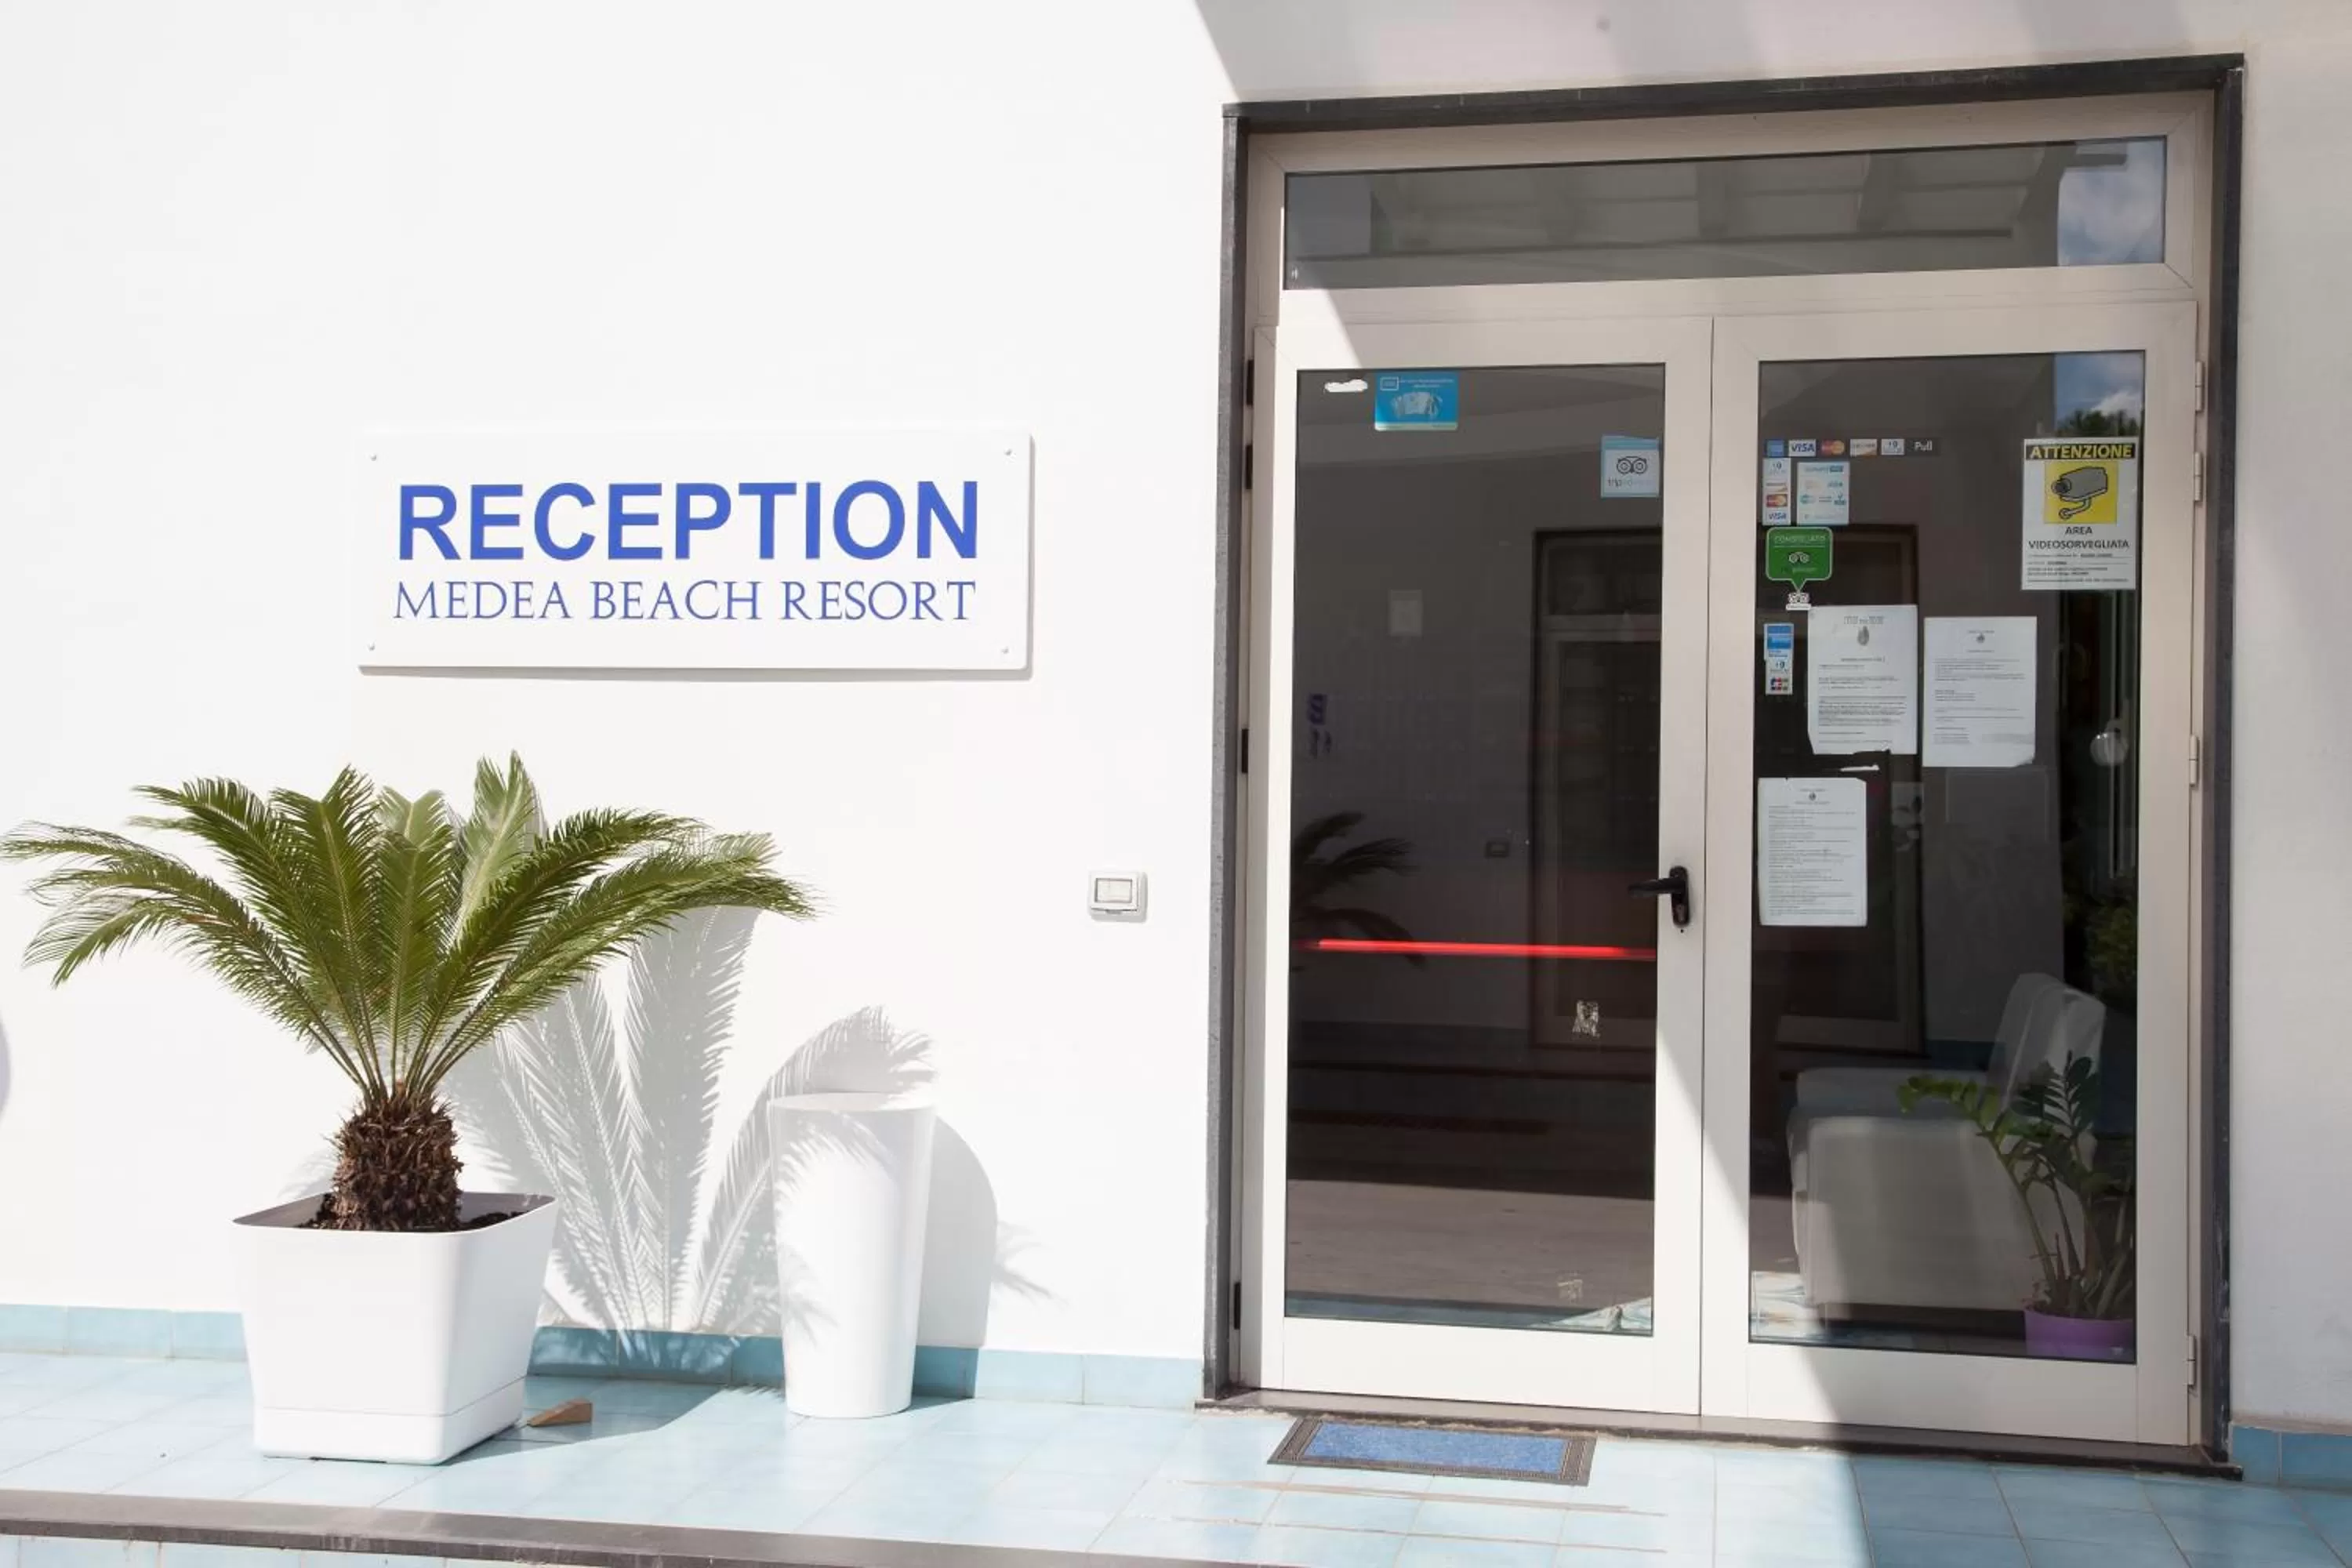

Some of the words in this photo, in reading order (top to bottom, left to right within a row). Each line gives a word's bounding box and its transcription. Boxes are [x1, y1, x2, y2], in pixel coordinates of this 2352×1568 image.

[1791, 442, 1815, 452] VISA
[2030, 445, 2132, 459] ATTENZIONE
[397, 478, 978, 561] RECEPTION
[2064, 526, 2093, 535] AREA
[2027, 539, 2131, 550] VIDEOSORVEGLIATA
[394, 580, 569, 620] MEDEA
[590, 579, 760, 620] BEACH
[782, 579, 977, 621] RESORT
